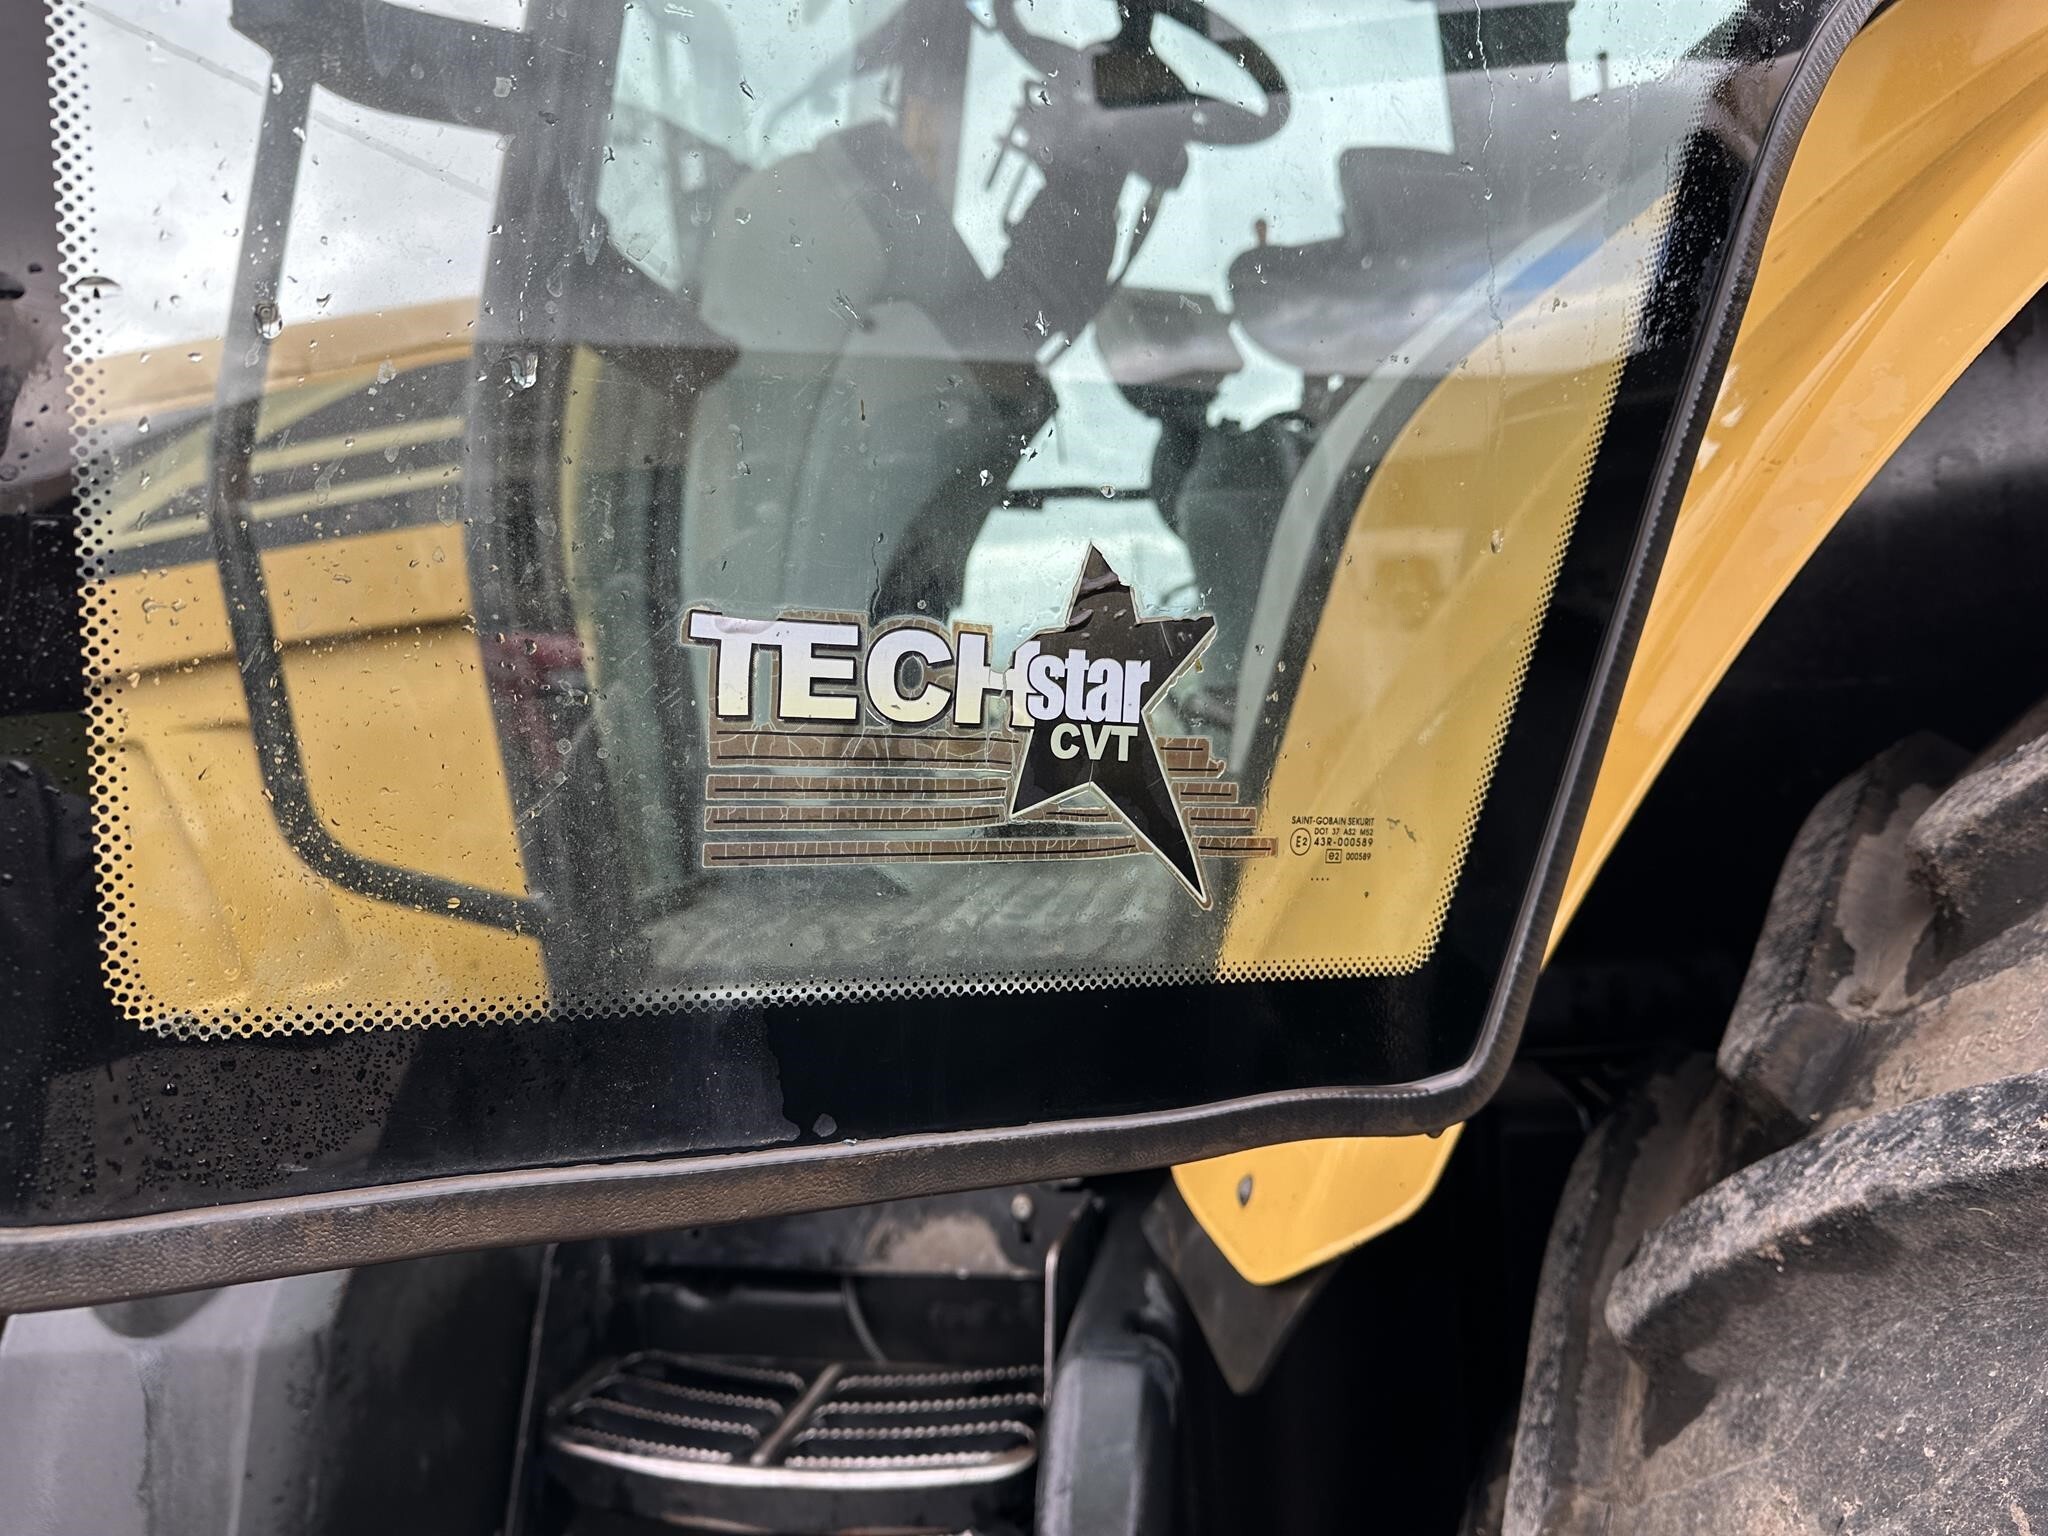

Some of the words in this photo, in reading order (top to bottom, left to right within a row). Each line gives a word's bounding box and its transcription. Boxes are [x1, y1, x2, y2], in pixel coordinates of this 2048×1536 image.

[1050, 722, 1139, 762] CVT
[1291, 816, 1346, 825] SAINT-GOBAIN
[1347, 817, 1375, 826] SEKURIT
[1314, 827, 1329, 835] DOT
[1332, 828, 1340, 836] 37
[1343, 828, 1356, 836] AS2
[1296, 835, 1308, 848] E2
[1314, 837, 1374, 847] 43R-000589
[1345, 853, 1372, 861] 000589
